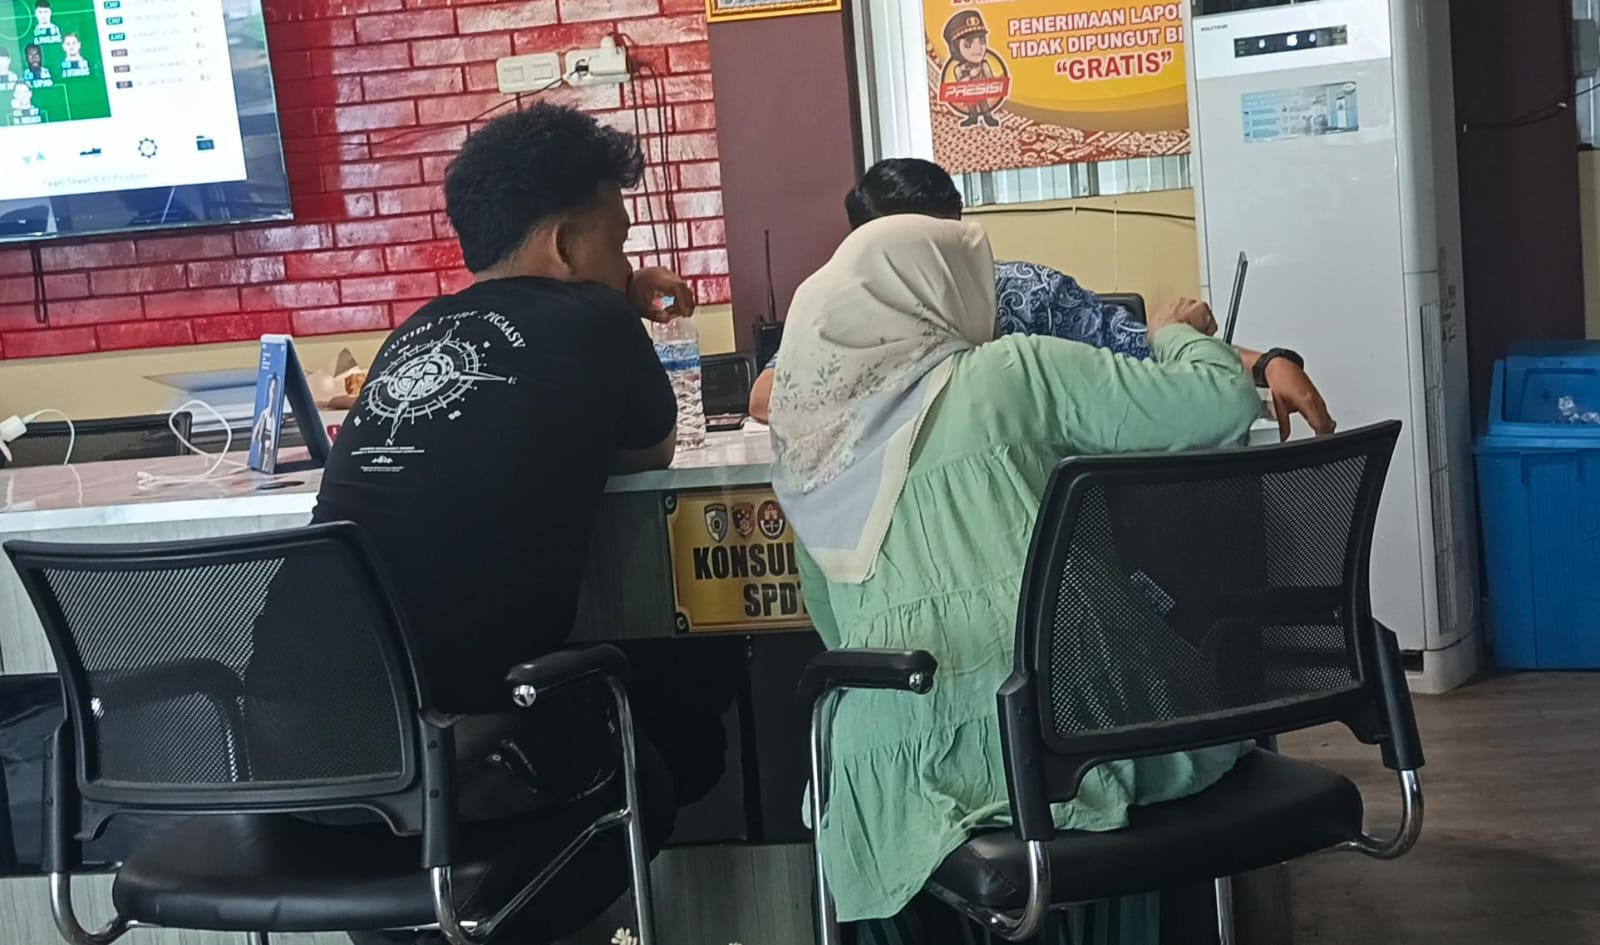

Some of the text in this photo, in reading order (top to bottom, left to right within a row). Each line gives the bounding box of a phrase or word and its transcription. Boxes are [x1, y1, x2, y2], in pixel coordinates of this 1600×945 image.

[1009, 9, 1125, 36] PENERIMAAN
[1009, 38, 1063, 58] TIDAK
[1068, 29, 1160, 52] DIPUNGUT
[944, 81, 1003, 98] PRESISI
[693, 543, 799, 580] KONSUL
